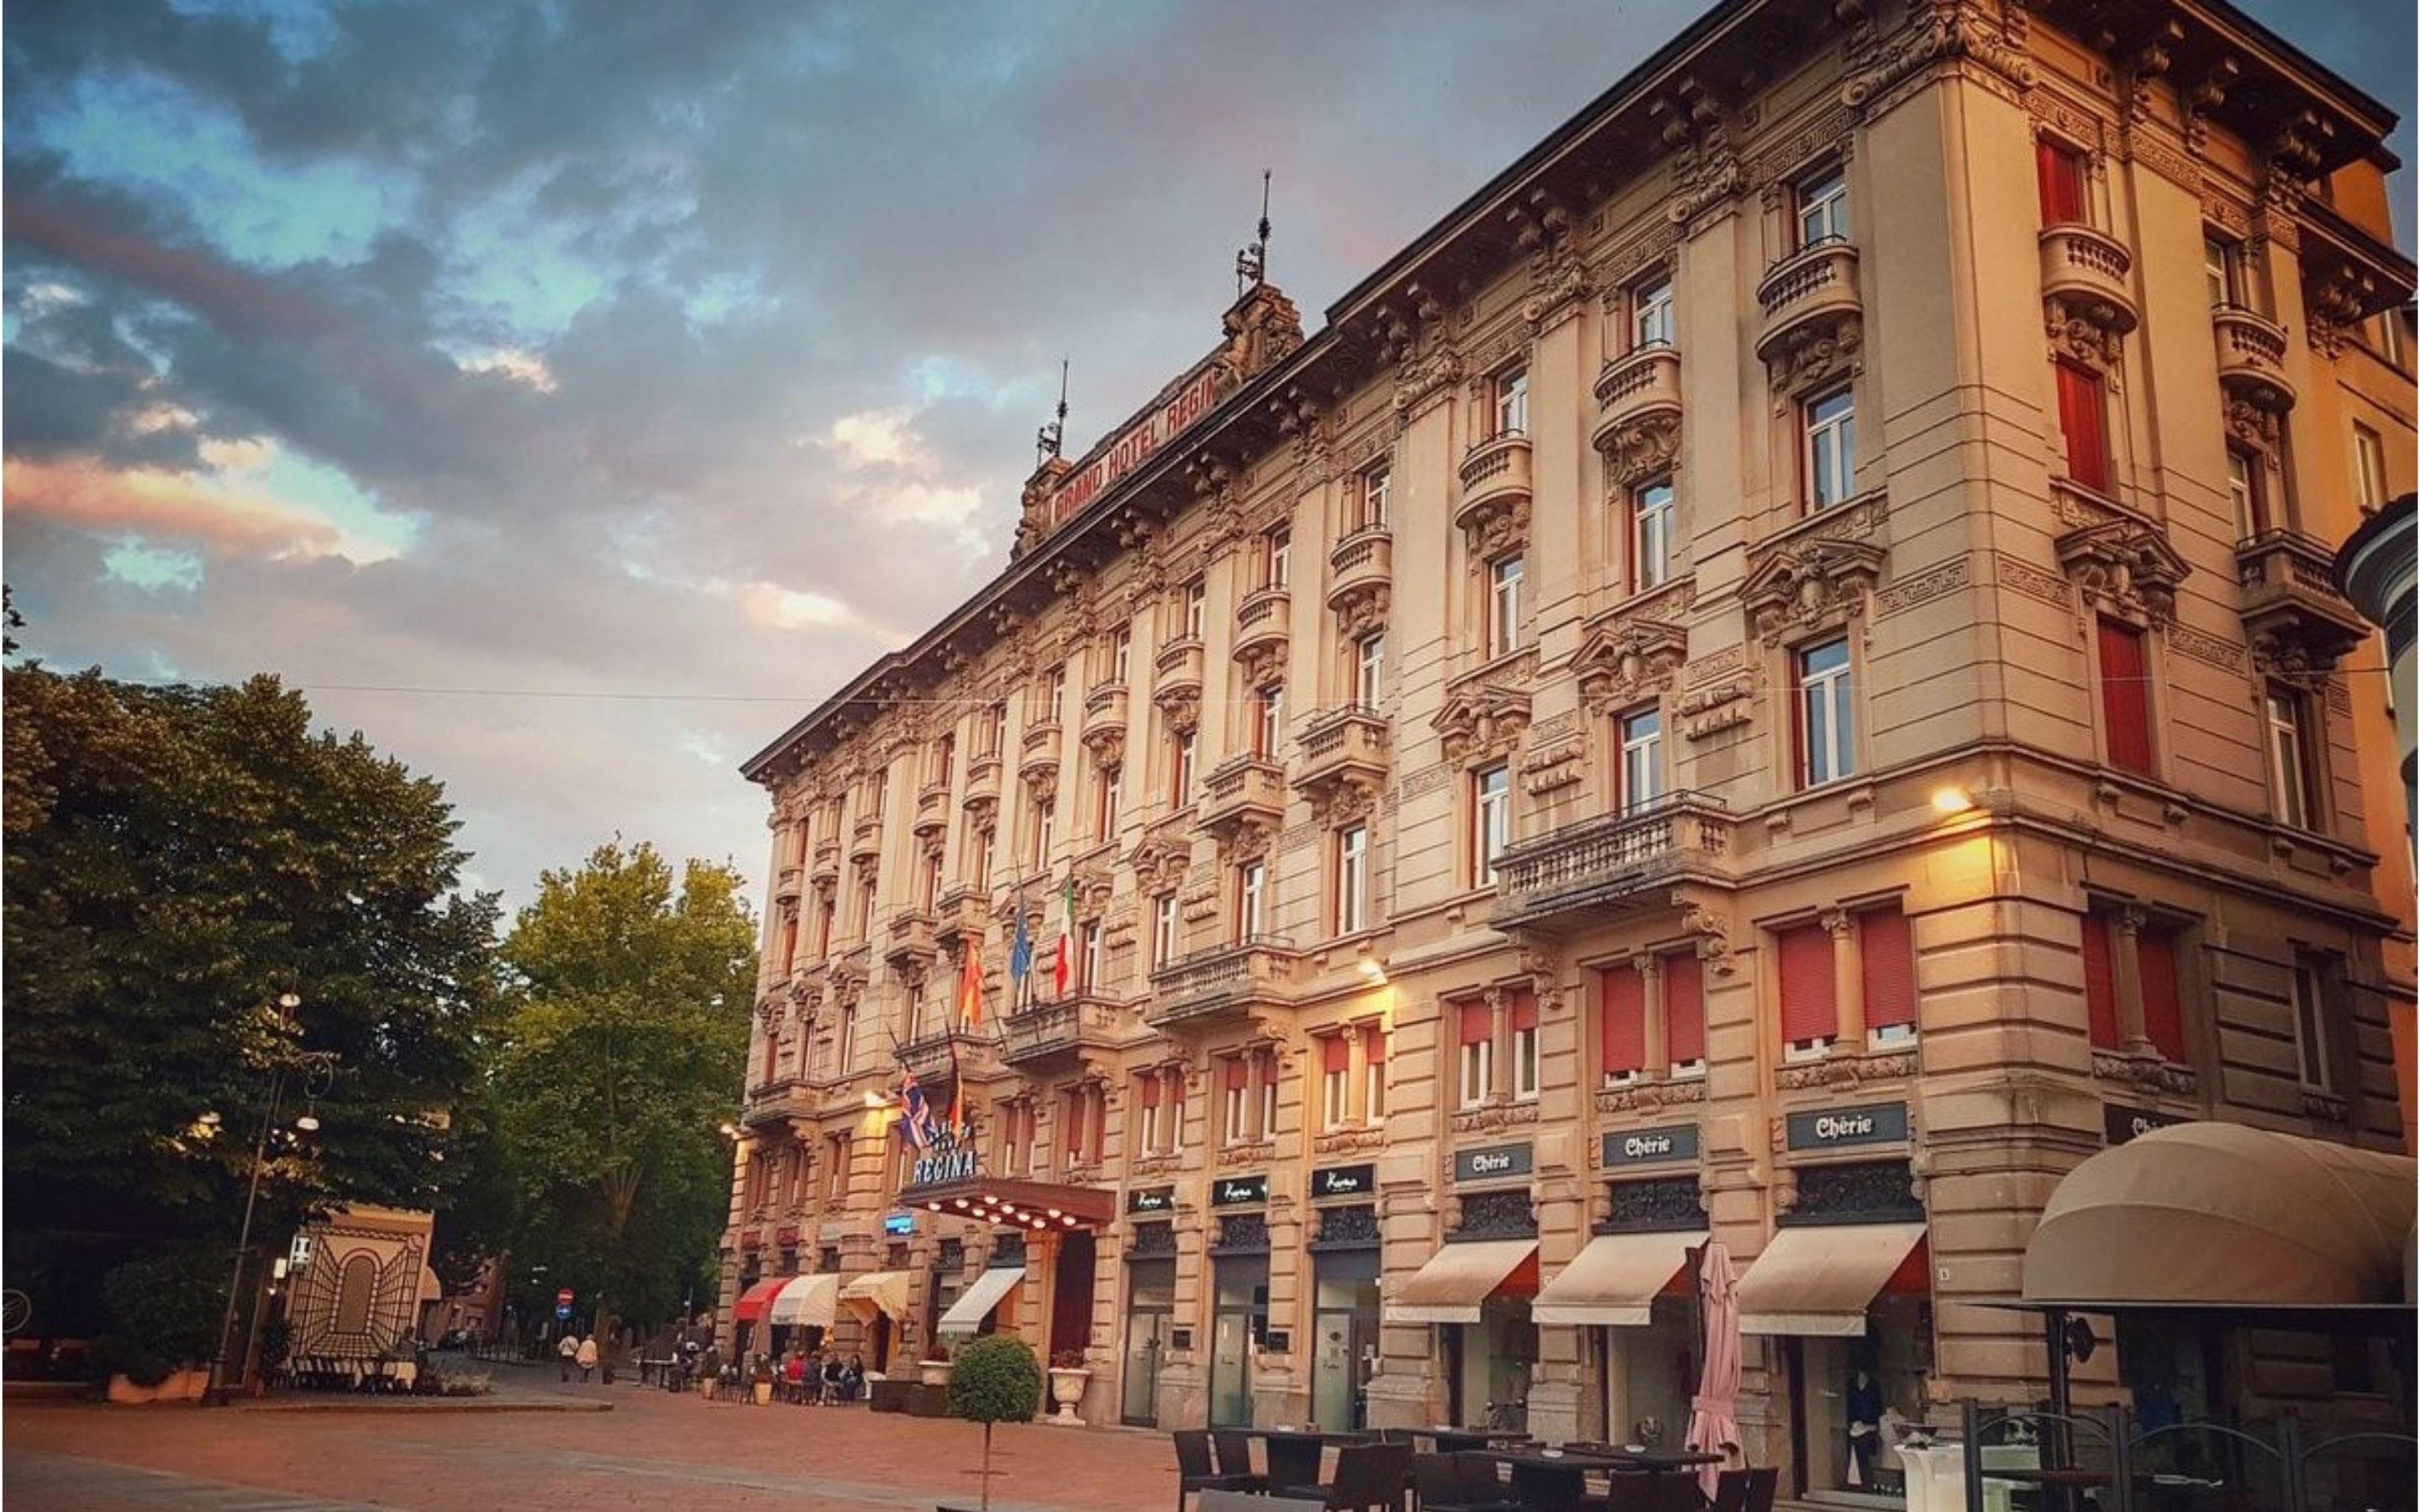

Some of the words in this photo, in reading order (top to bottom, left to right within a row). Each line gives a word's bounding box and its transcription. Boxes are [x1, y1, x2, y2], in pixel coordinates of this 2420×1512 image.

[1055, 463, 1103, 523] GRAND
[1108, 421, 1160, 478] HOTEL
[1167, 375, 1217, 435] REGIN
[1815, 1115, 1873, 1140] Chérie
[1624, 1136, 1671, 1158] Chérie
[913, 1151, 974, 1184] REGINA
